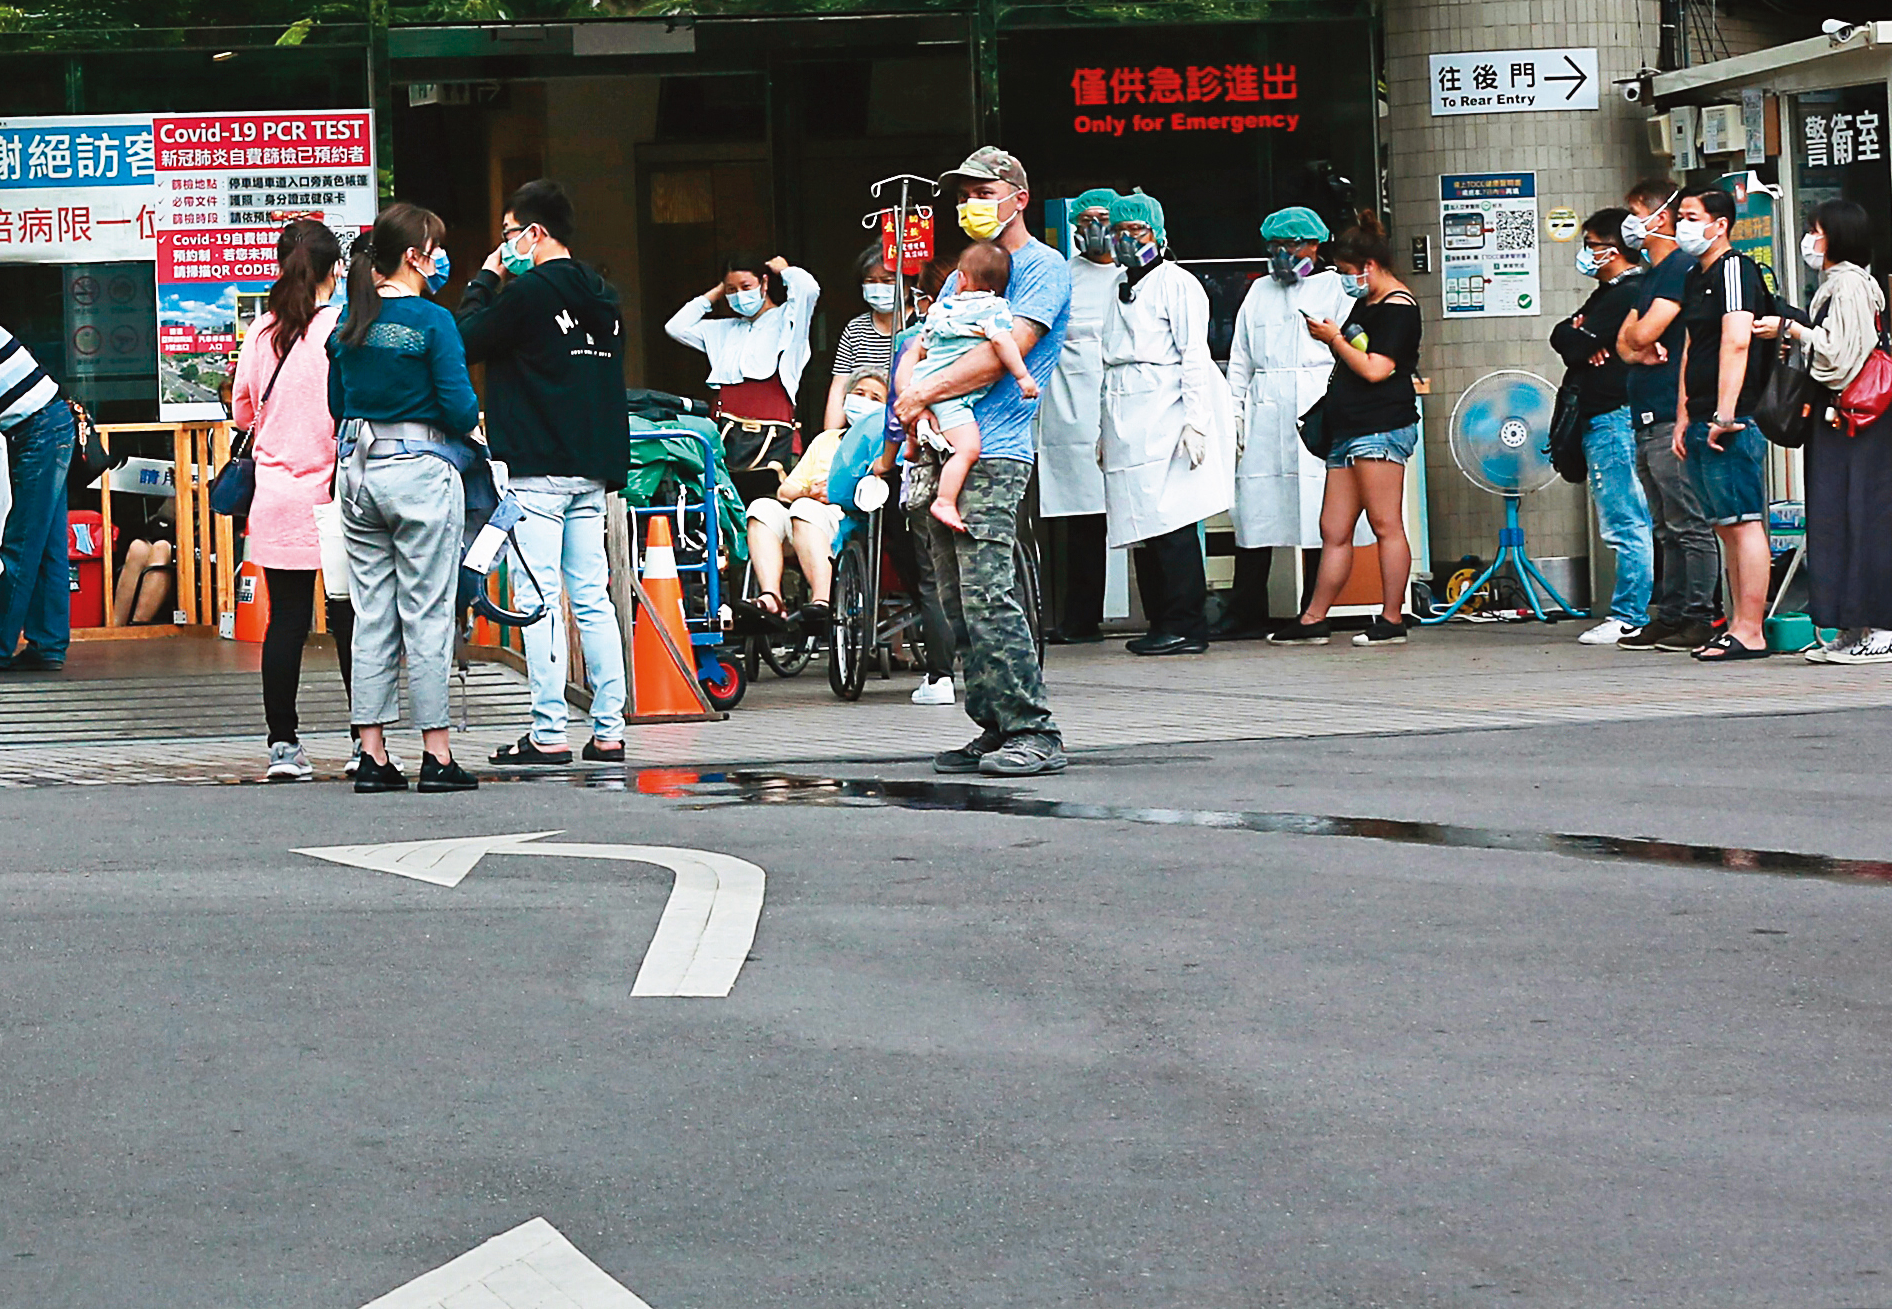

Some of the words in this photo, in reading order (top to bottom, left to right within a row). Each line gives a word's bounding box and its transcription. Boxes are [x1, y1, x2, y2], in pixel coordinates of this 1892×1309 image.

[1071, 63, 1298, 106] 僅供急診進出
[1438, 62, 1536, 92] 往後門
[1441, 97, 1456, 108] To
[1461, 95, 1493, 107] Rear
[1497, 94, 1536, 106] Entry
[160, 121, 257, 144] Covid-19
[263, 123, 307, 141] PCR
[311, 119, 365, 140] TEST
[1074, 115, 1126, 137] Only
[1132, 114, 1165, 132] for
[1170, 112, 1300, 134] Emergency
[1805, 110, 1882, 168] 警衛室
[161, 146, 365, 168] 新冠肺炎自費篩檢已預約者
